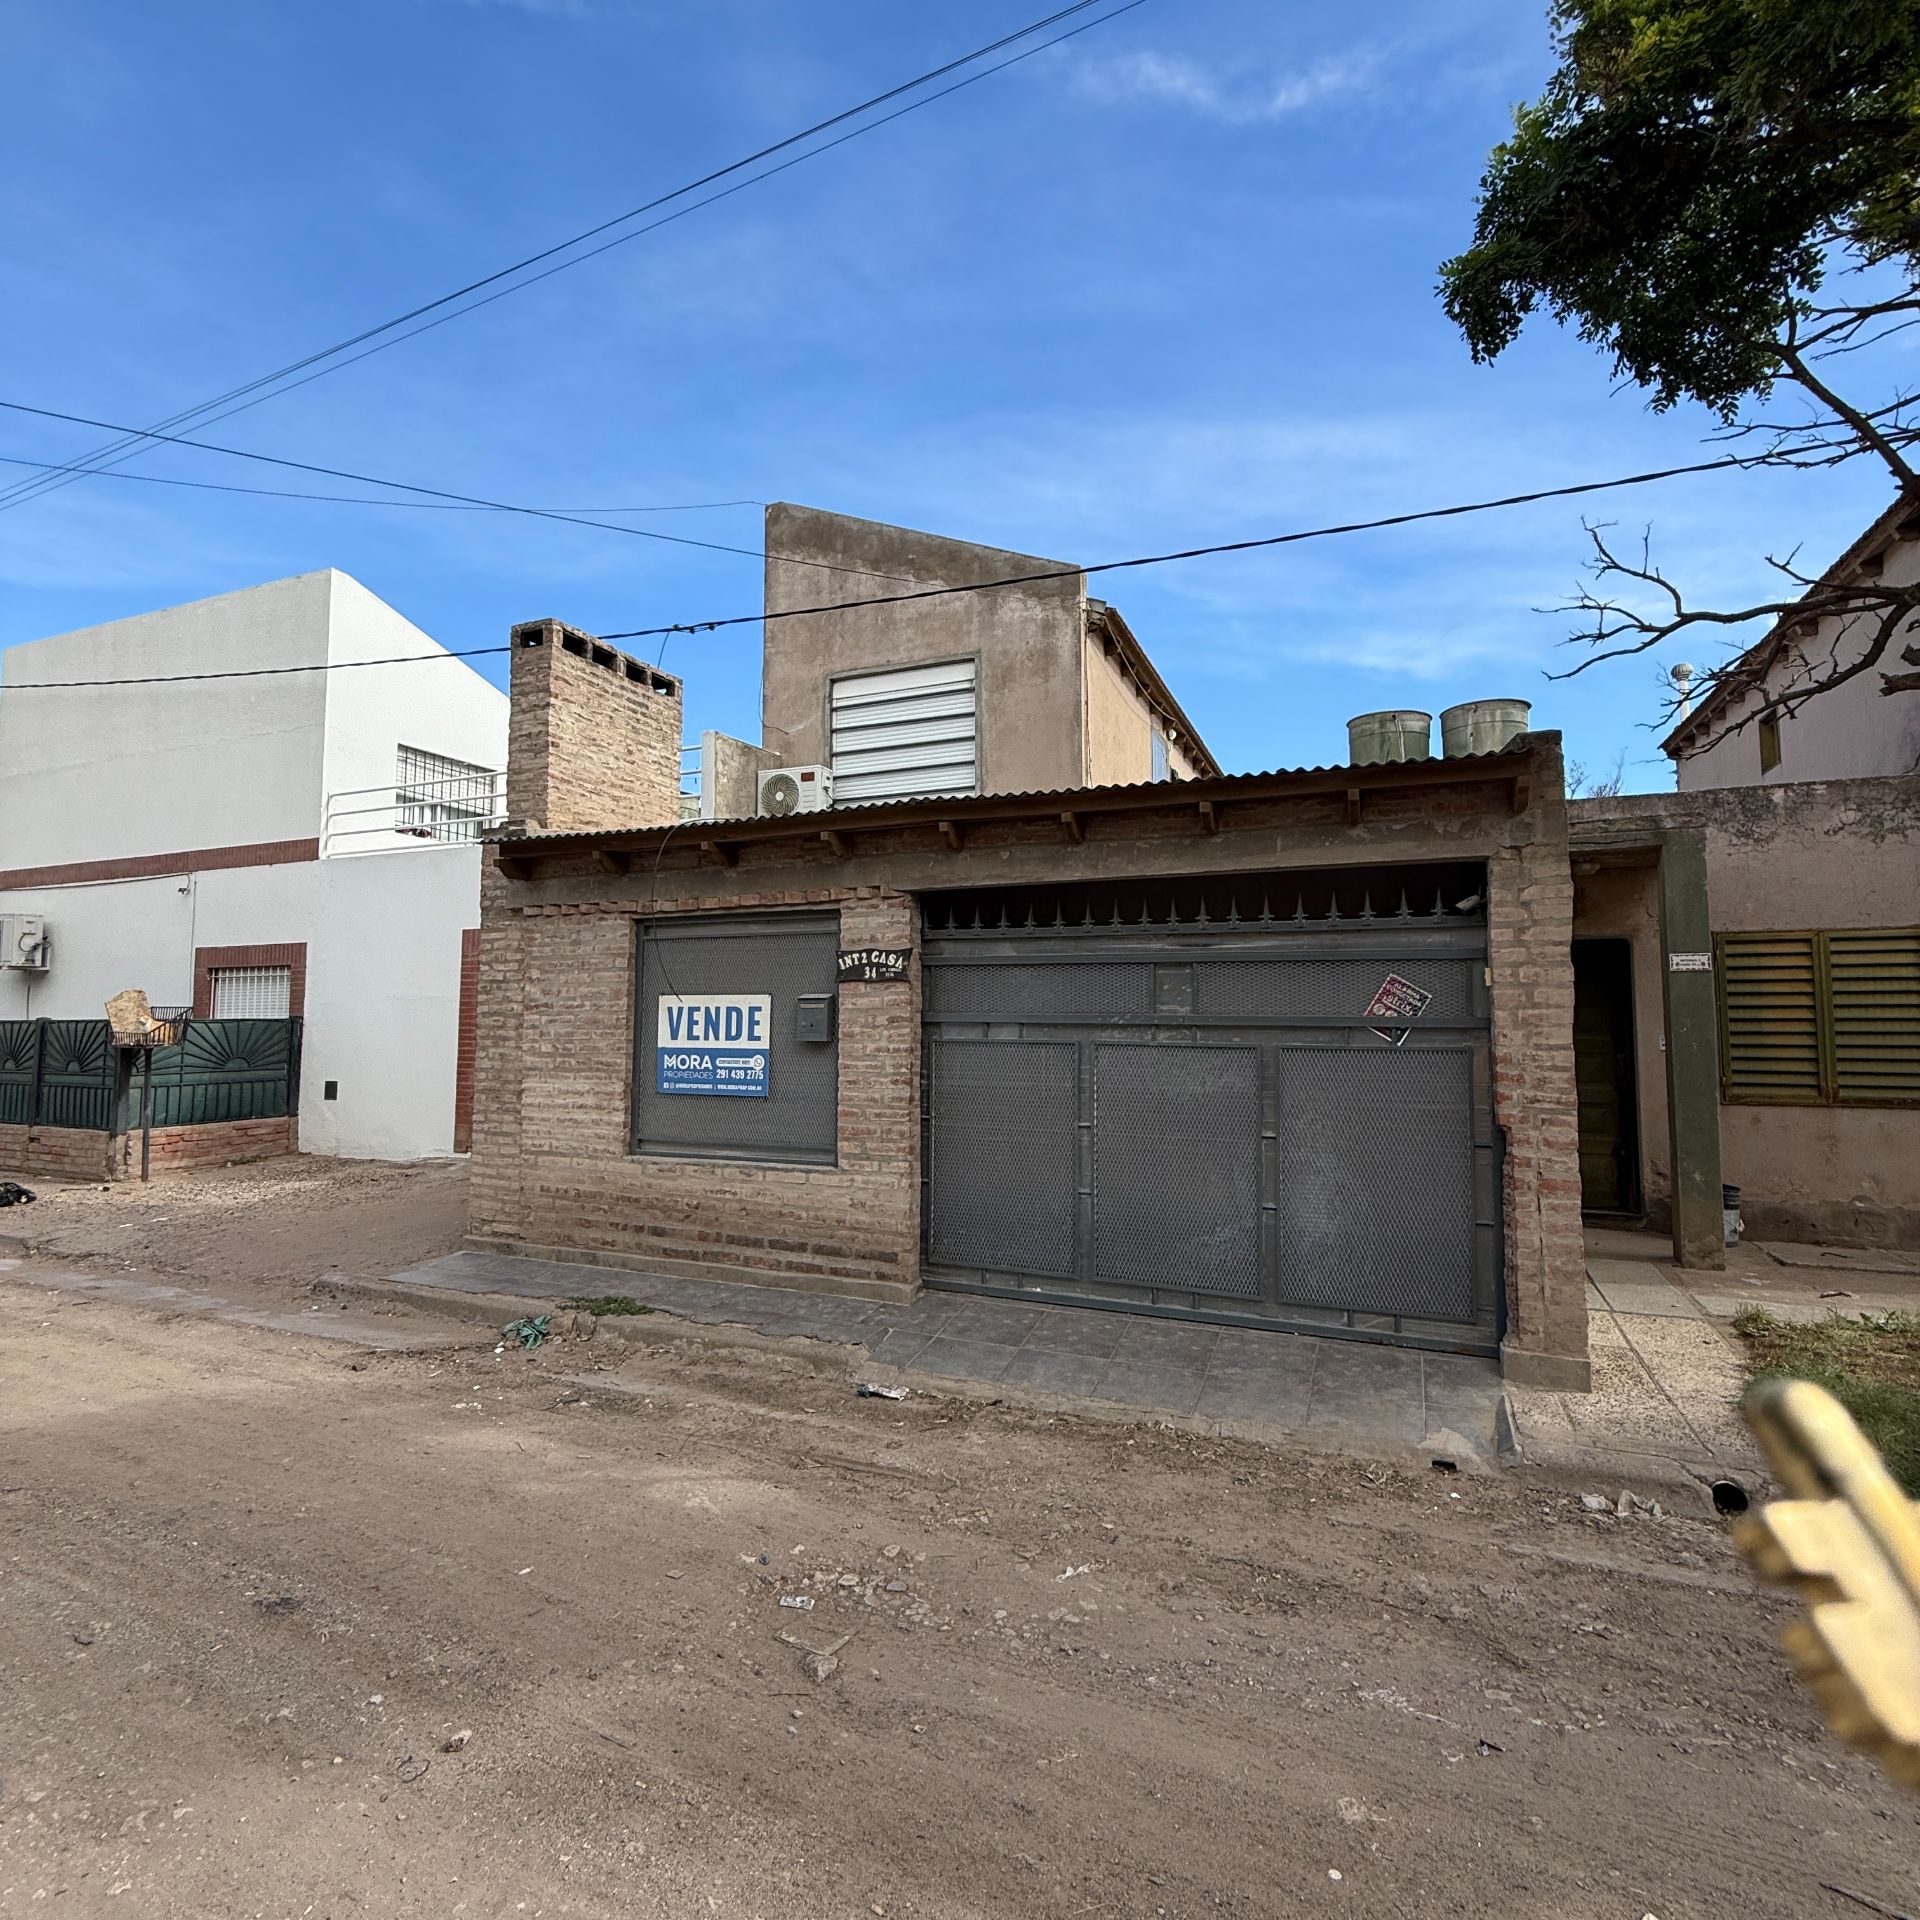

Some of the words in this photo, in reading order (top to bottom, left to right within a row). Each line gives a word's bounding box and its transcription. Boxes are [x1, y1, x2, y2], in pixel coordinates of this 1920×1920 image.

[871, 951, 904, 969] CASA
[864, 966, 877, 979] 34
[1386, 985, 1422, 1007] CONECTADA
[1394, 983, 1421, 1000] ALARMA
[667, 1006, 762, 1041] VENDE
[663, 1054, 713, 1070] MORA
[663, 1070, 714, 1079] PROPIEDADES
[716, 1069, 729, 1079] 291
[731, 1069, 745, 1080] 439
[746, 1069, 764, 1080] 2775
